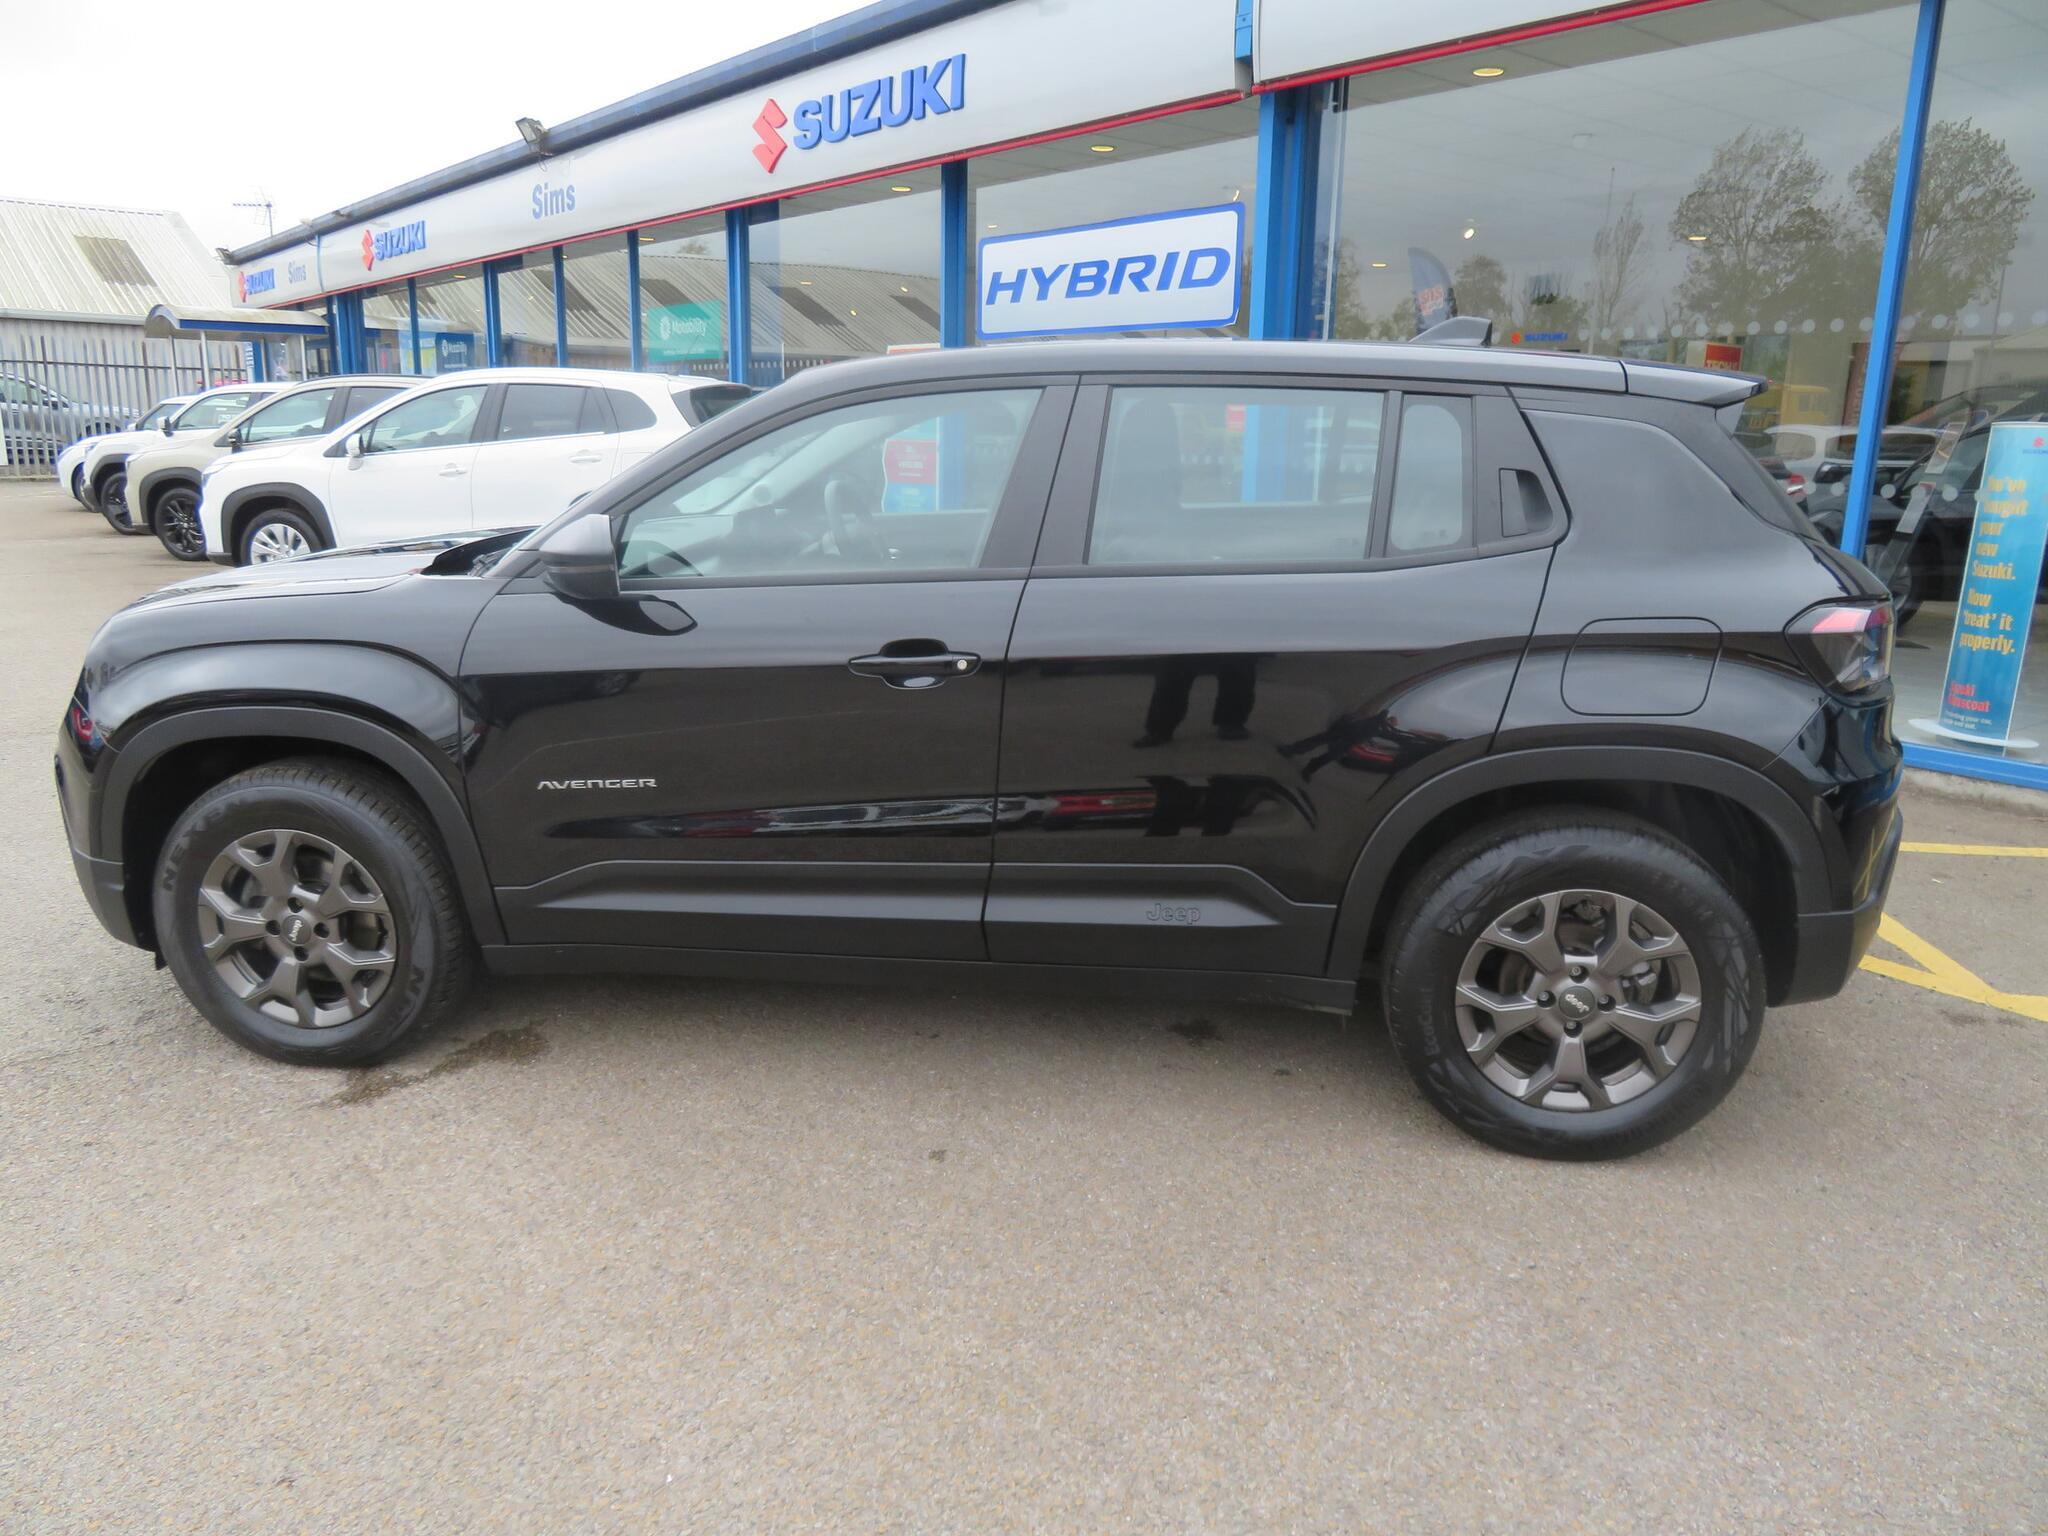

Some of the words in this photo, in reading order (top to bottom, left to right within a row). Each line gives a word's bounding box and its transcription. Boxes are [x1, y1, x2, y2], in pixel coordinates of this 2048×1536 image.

[793, 53, 966, 150] SUZUKI
[532, 182, 575, 219] Sims
[374, 219, 426, 262] SUZUKI
[245, 268, 276, 296] SUZUKI
[288, 261, 307, 285] Sims
[985, 247, 1231, 306] HYBRID
[2000, 614, 2014, 631] it
[537, 778, 658, 790] AVENGER
[1145, 902, 1201, 925] Jeep
[1564, 994, 1590, 1013] Jeep
